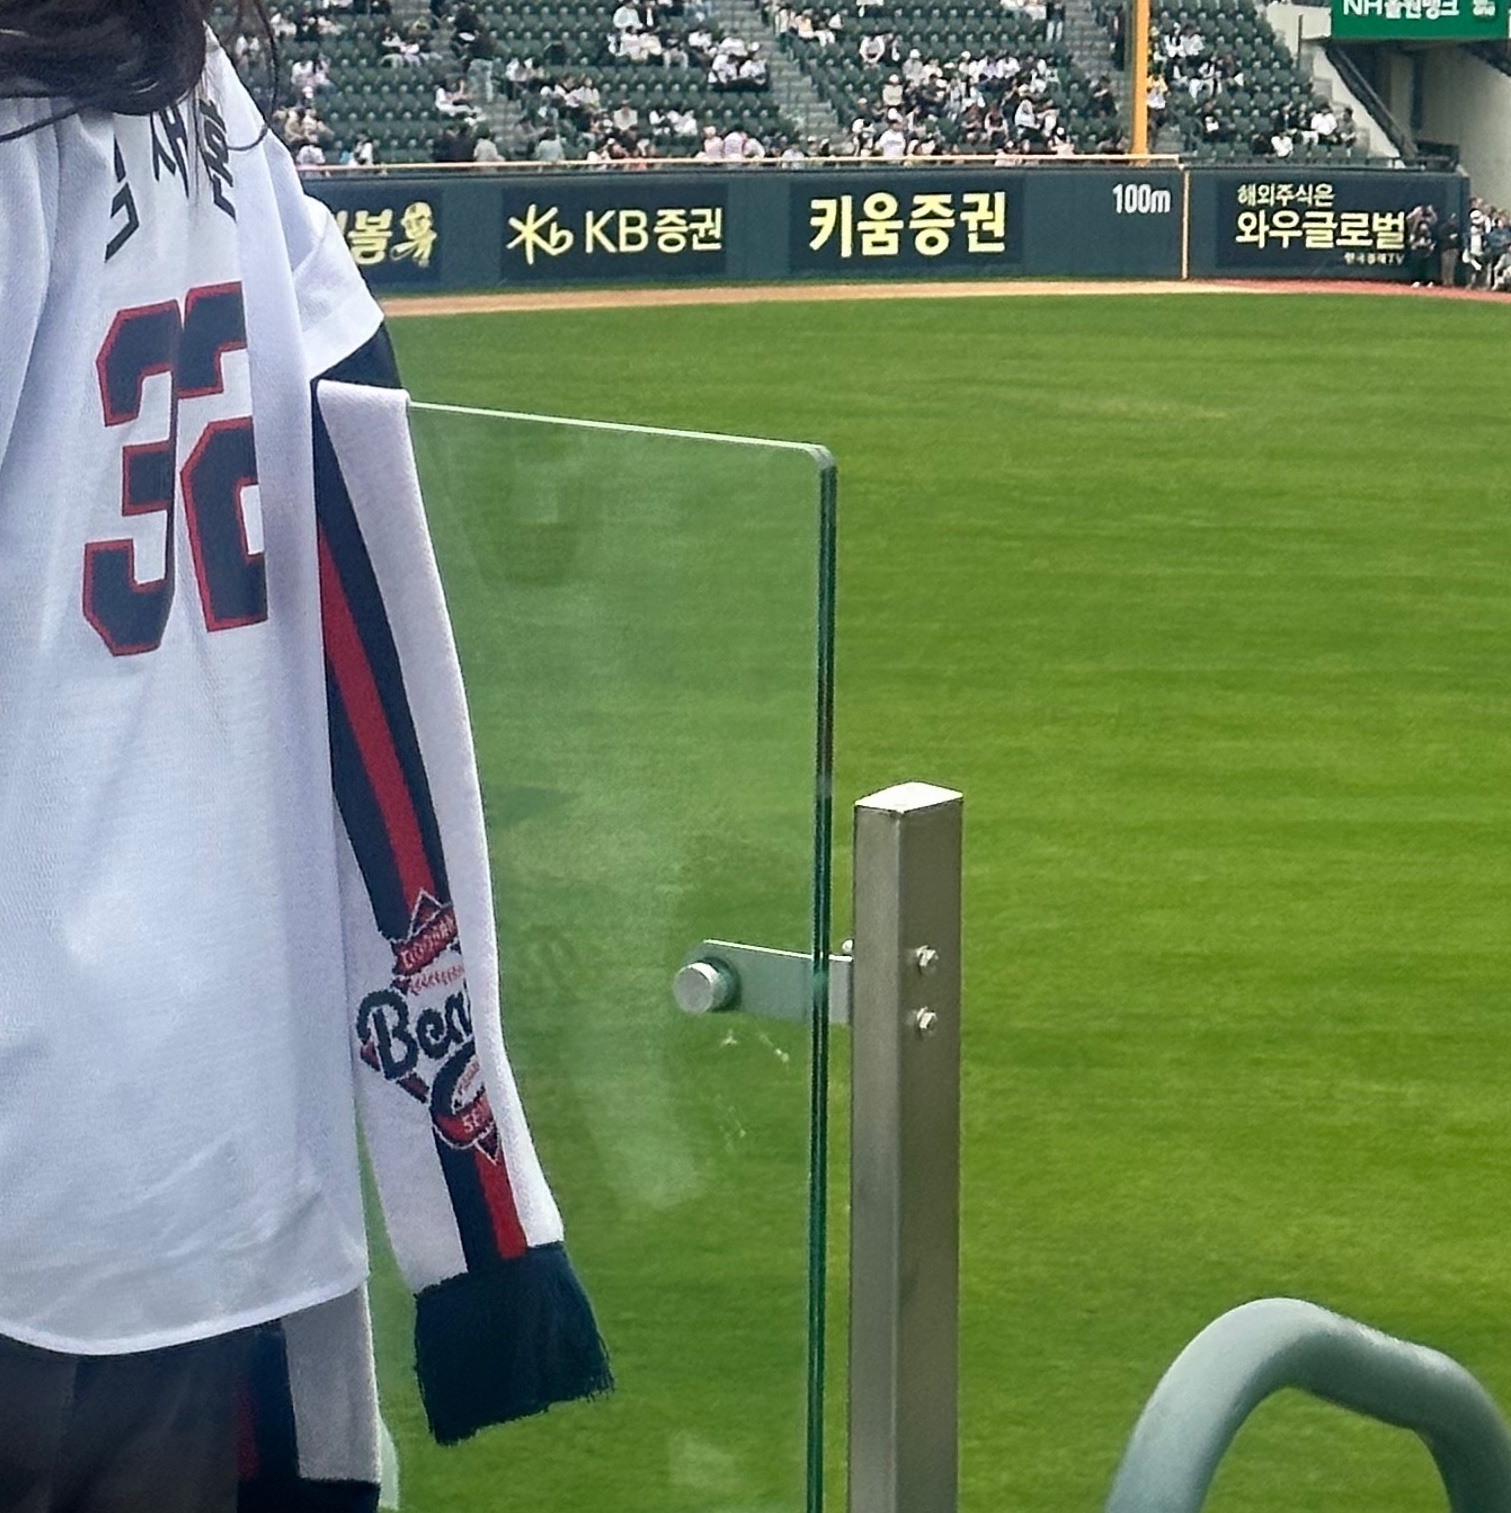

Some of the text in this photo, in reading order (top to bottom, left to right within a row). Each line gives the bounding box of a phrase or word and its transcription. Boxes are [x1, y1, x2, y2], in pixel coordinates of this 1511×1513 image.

[1112, 183, 1171, 214] 100m
[1237, 183, 1336, 207] 해외주식은
[809, 191, 1007, 258] 키움증권
[1235, 209, 1406, 250] 와우글로벌
[82, 281, 269, 657] 32
